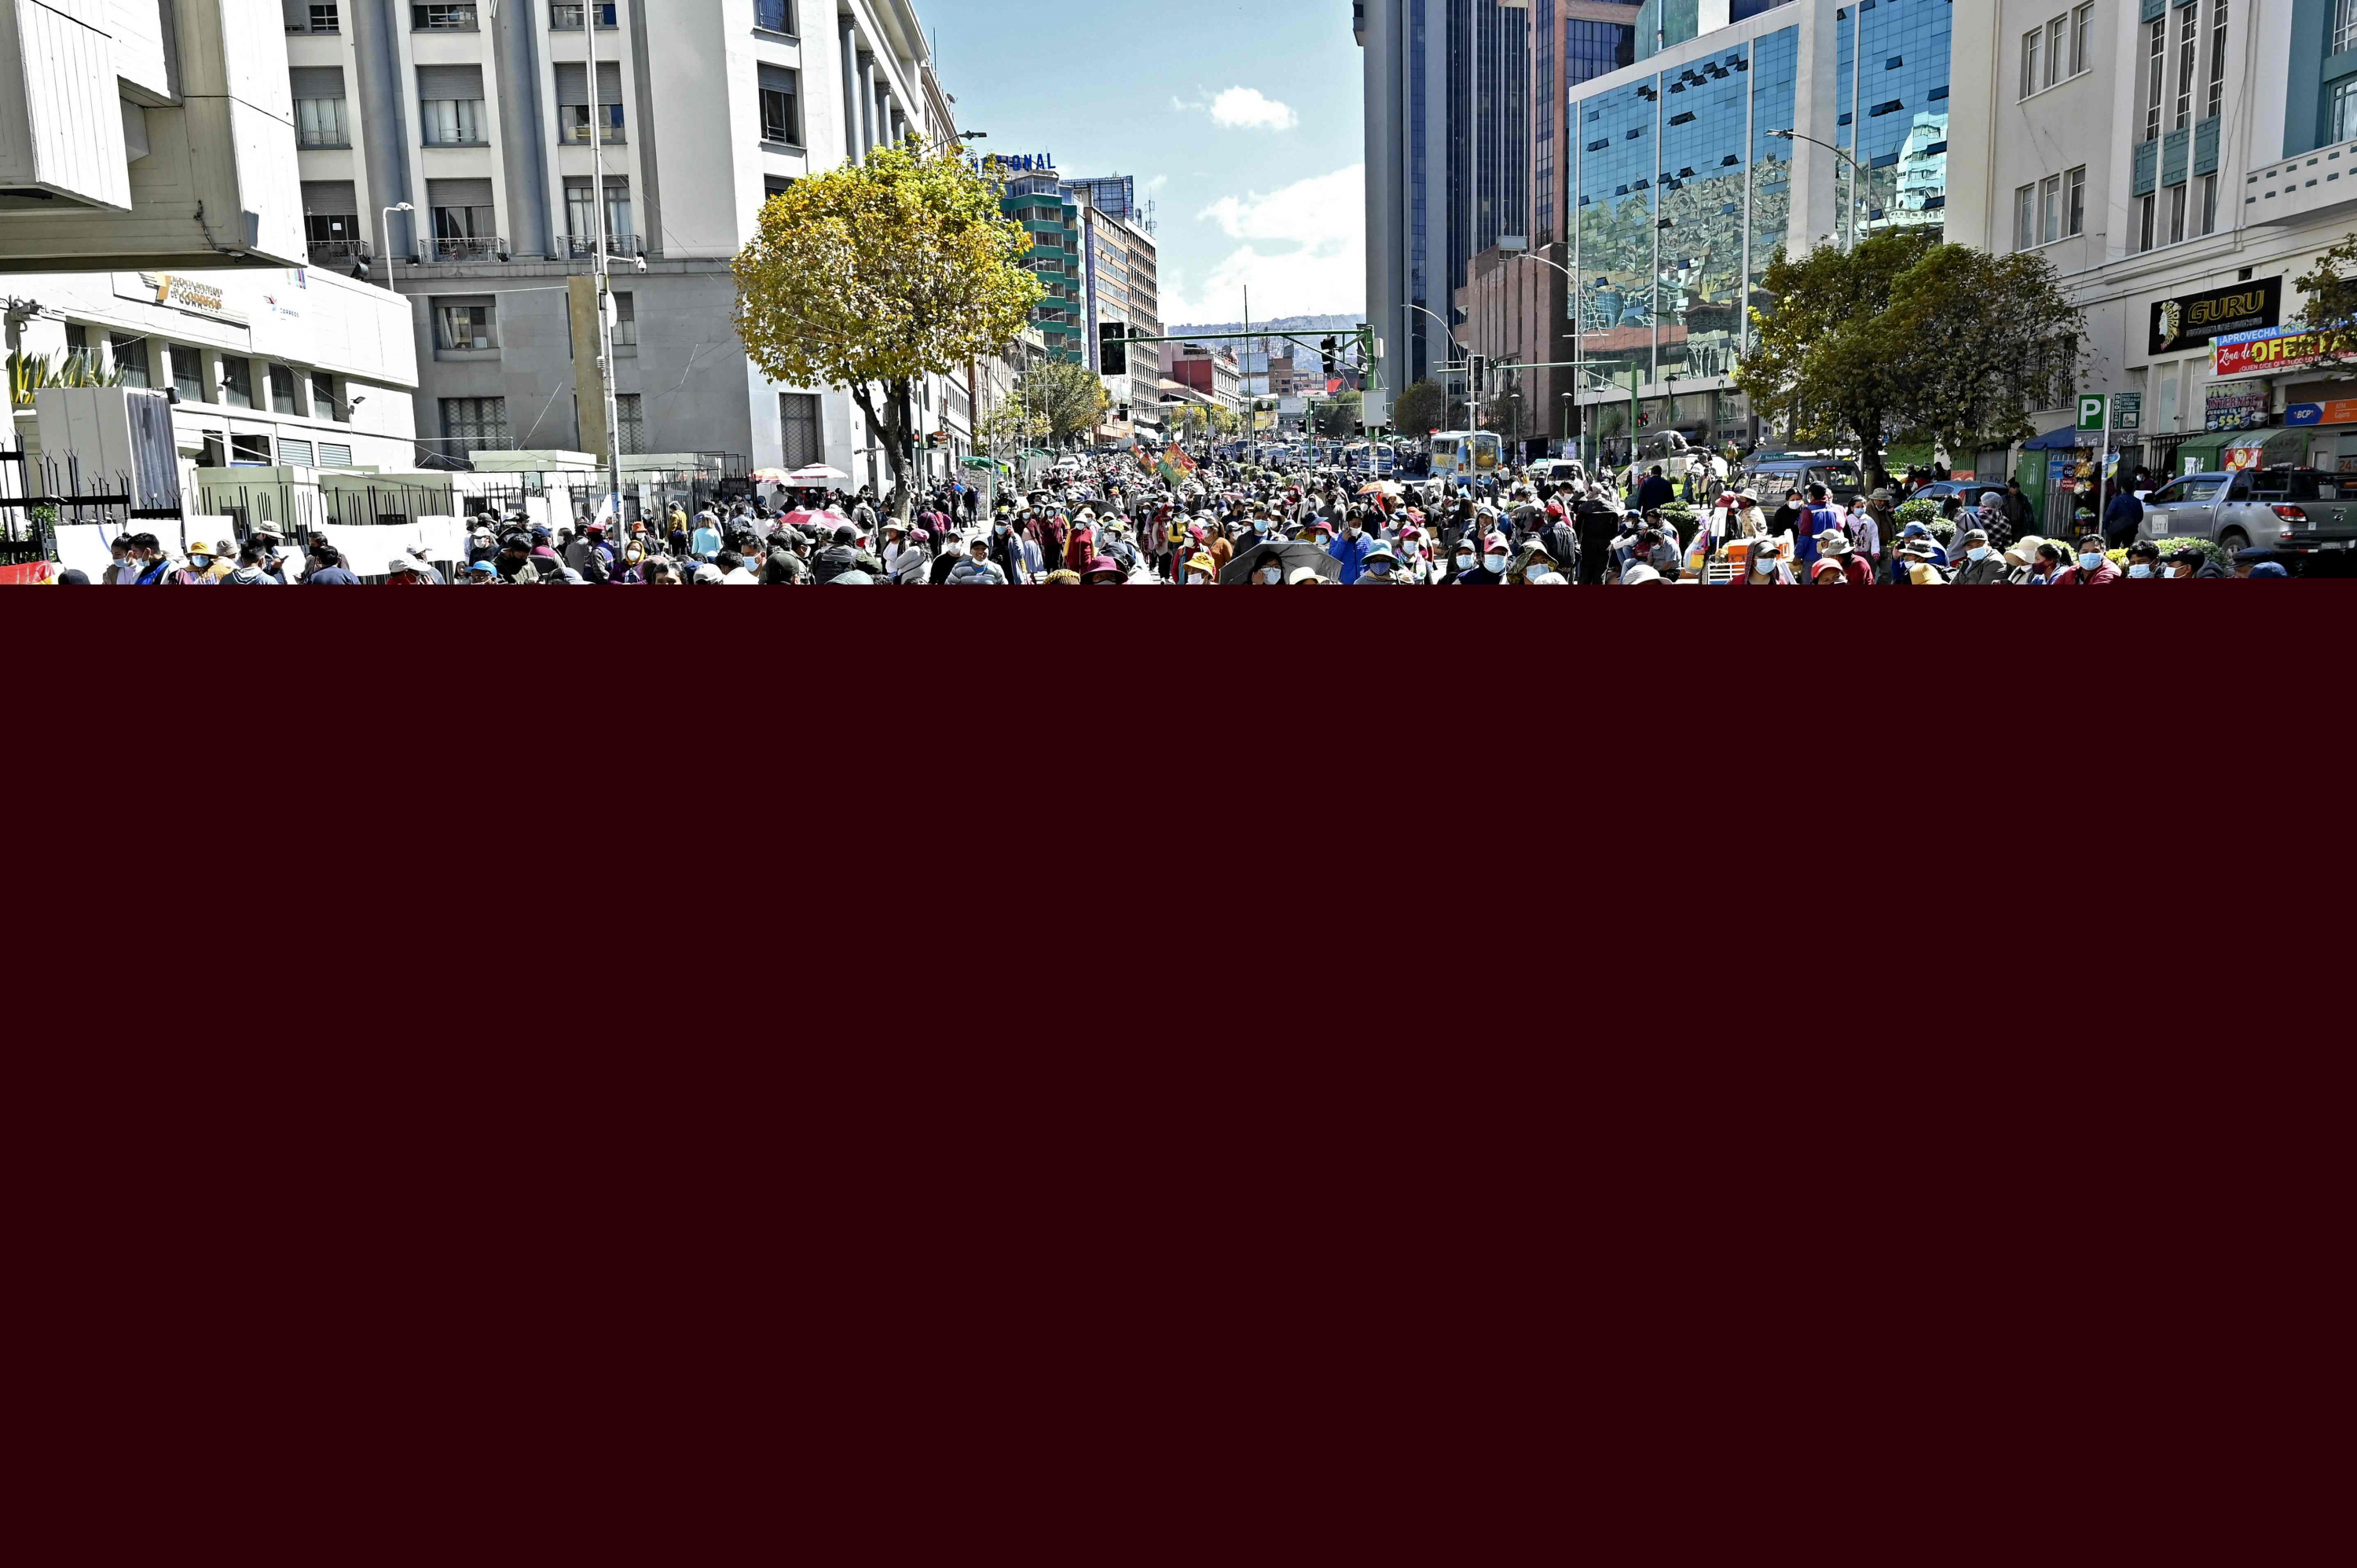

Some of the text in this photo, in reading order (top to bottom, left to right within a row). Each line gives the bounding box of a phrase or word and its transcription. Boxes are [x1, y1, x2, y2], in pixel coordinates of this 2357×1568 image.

[971, 152, 1056, 174] NIONAL
[2188, 290, 2264, 324] GURU
[2220, 328, 2277, 346] ¡APROVECHA
[2219, 348, 2239, 366] Zona
[2241, 343, 2251, 361] de
[2207, 394, 2257, 409] INTERNET
[2080, 399, 2102, 426] P
[2218, 415, 2242, 427] 555
[2297, 409, 2311, 419] BCP
